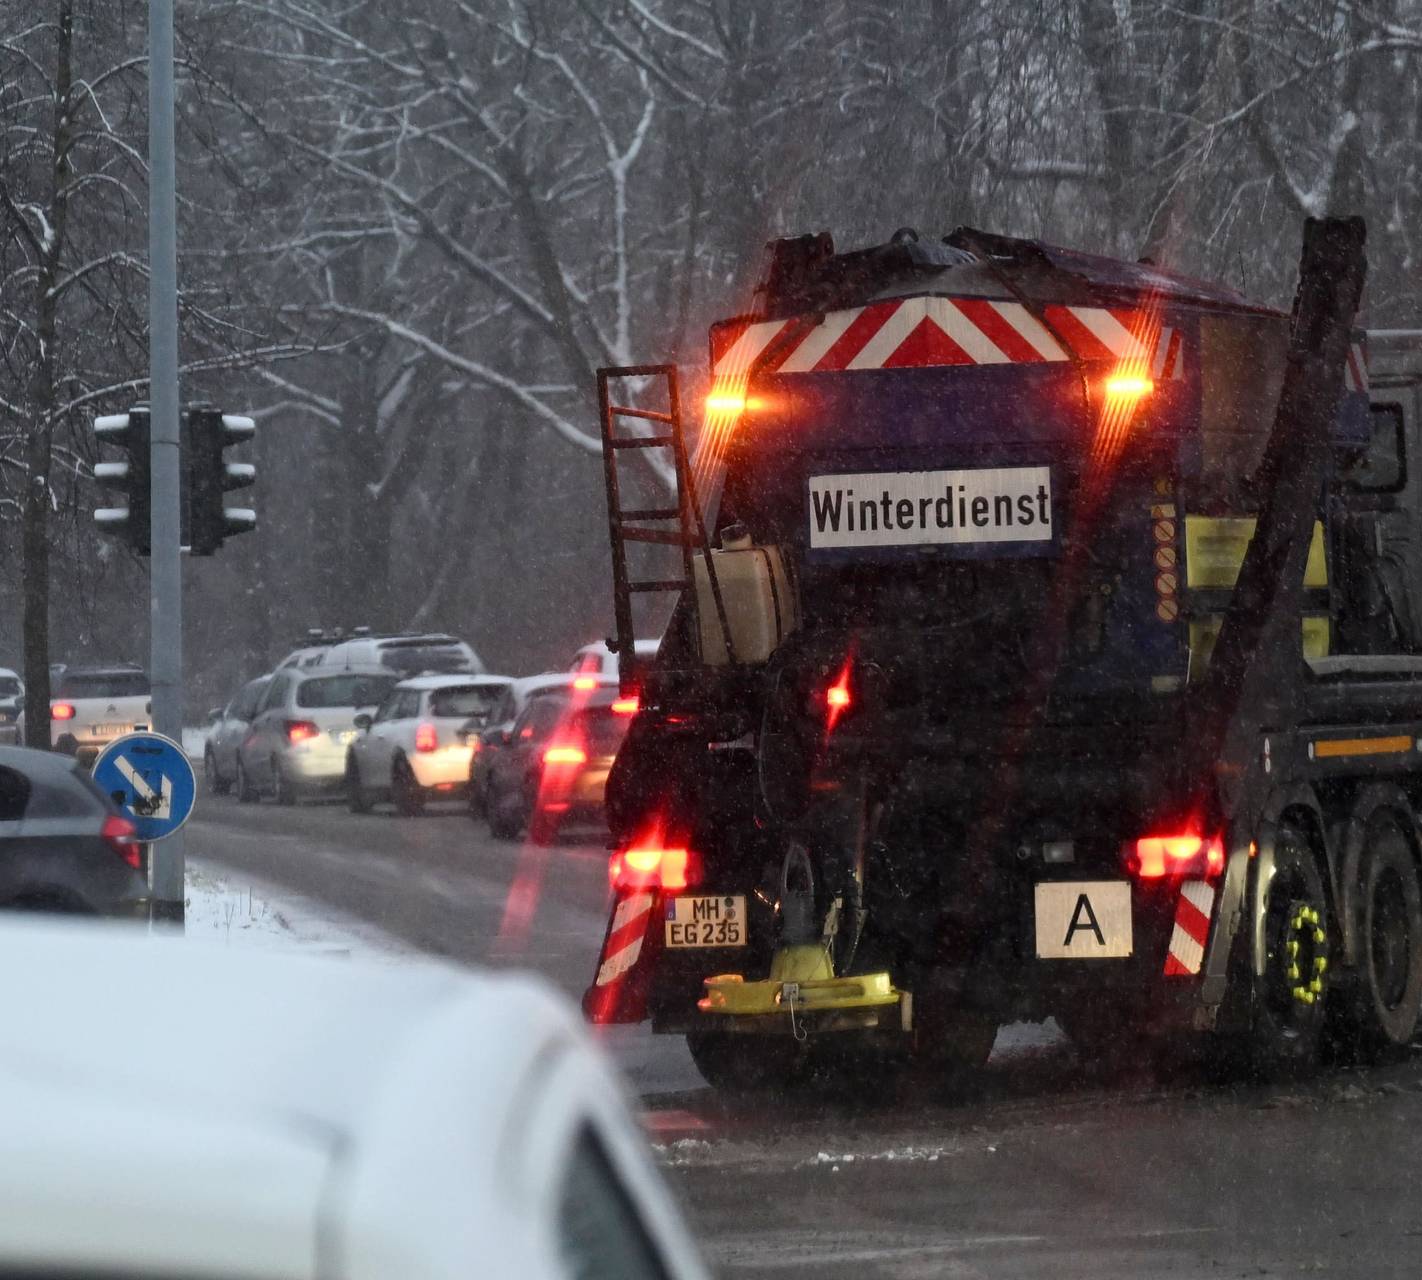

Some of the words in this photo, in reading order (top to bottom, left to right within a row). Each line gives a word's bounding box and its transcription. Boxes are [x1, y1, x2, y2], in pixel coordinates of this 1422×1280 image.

[812, 485, 1050, 533] Winterdienst
[693, 898, 720, 920] MH
[1063, 893, 1106, 946] A
[671, 923, 698, 945] EG
[702, 922, 740, 944] 235
